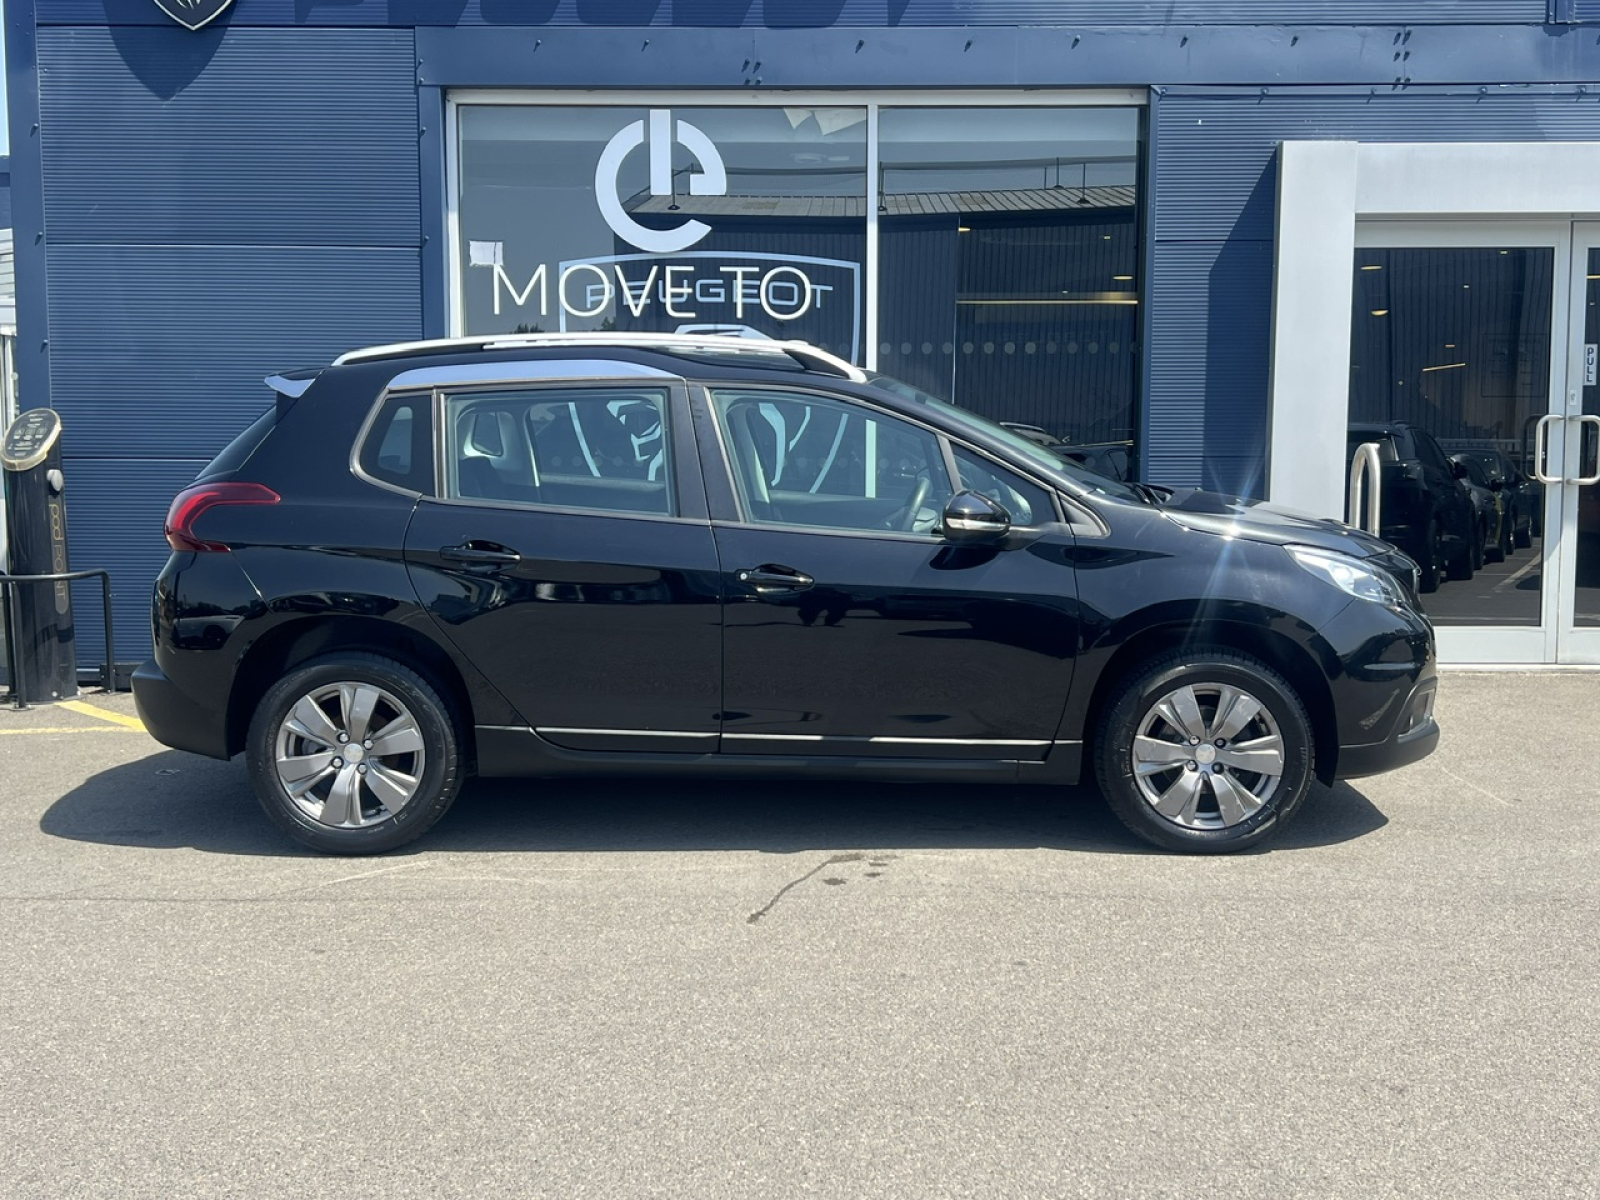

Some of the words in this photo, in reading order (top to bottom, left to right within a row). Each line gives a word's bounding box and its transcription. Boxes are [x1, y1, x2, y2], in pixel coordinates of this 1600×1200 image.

[493, 263, 697, 319] MOVE
[719, 266, 812, 320] TO
[585, 278, 834, 309] PEUGEOT
[1586, 346, 1595, 383] PULL
[48, 504, 64, 541] pod
[53, 545, 66, 600] PONT
